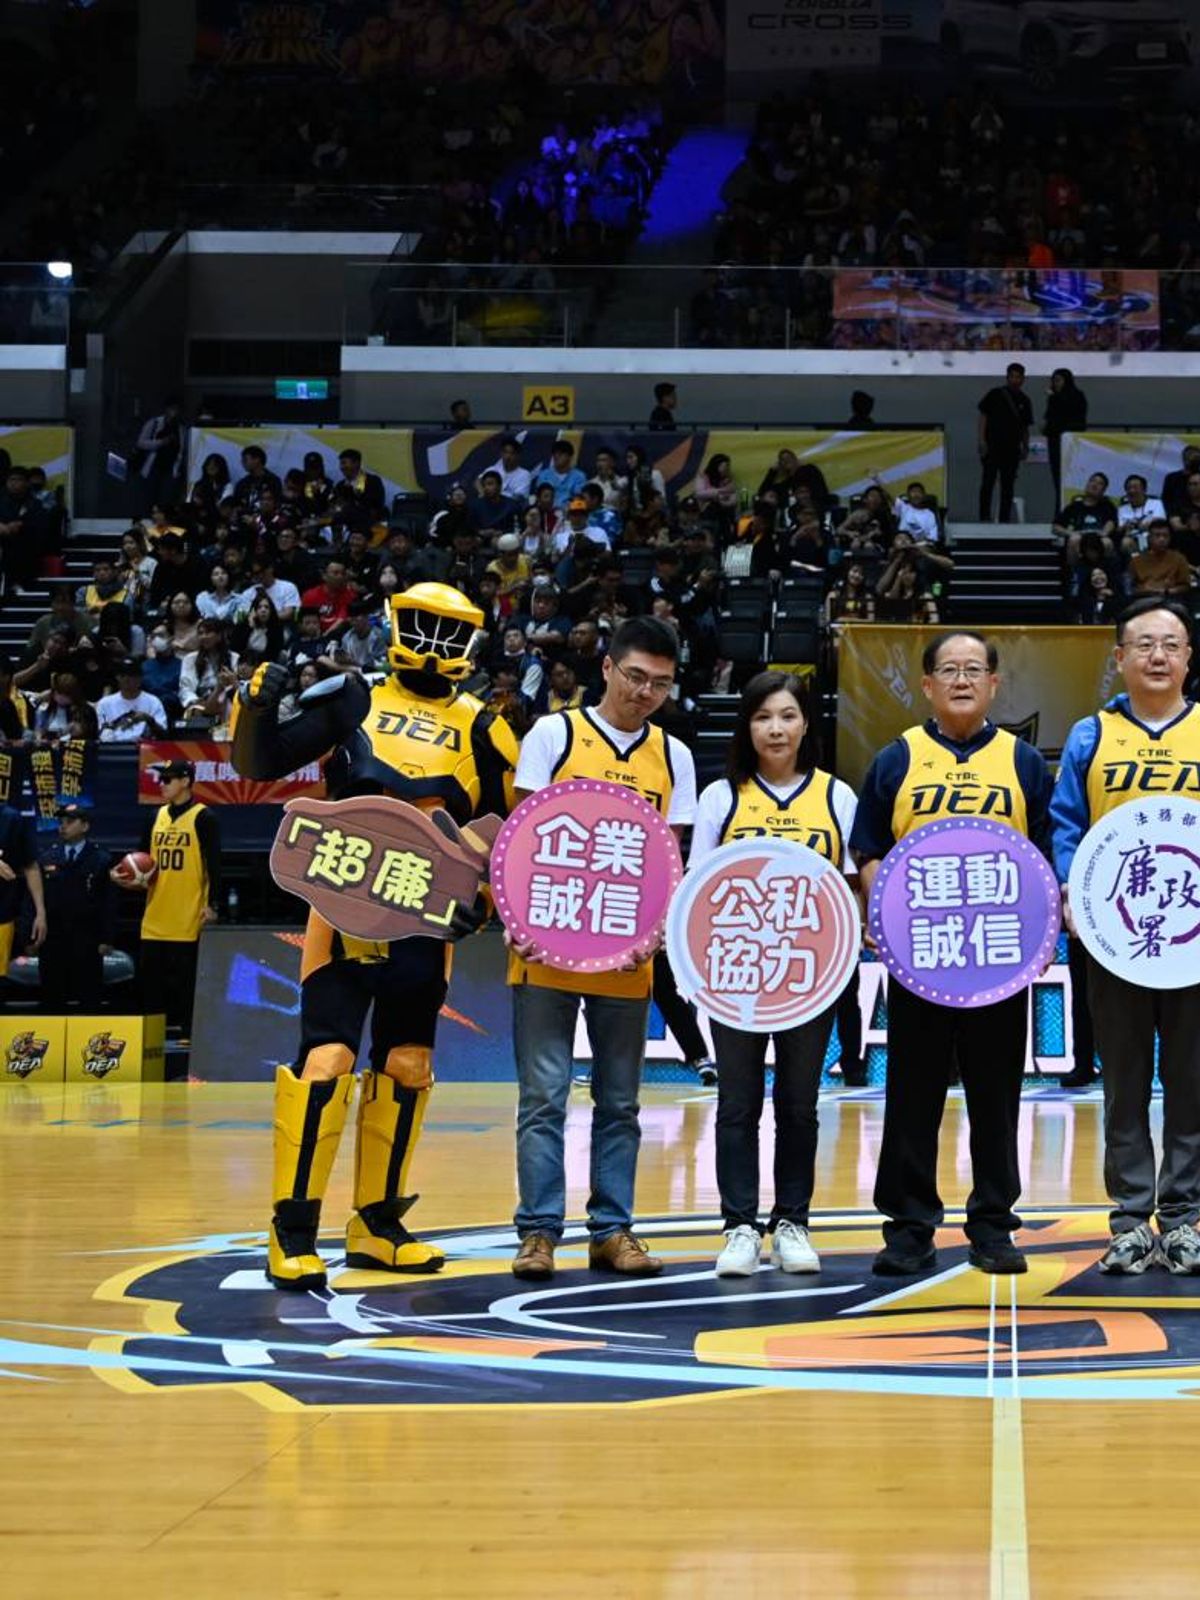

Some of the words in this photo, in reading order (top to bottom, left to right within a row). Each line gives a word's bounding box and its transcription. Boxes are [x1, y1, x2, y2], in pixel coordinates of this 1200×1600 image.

[748, 14, 912, 30] CROSS
[526, 395, 569, 416] A3
[376, 711, 461, 753] DEA
[1137, 748, 1172, 757] CTBC
[604, 770, 638, 784] CTBC
[945, 771, 979, 781] CTBC
[911, 783, 1012, 817] DEA
[766, 816, 799, 827] CTBC
[1134, 808, 1197, 827] 法務部
[534, 814, 647, 877] 企業
[908, 852, 1020, 909] 運動
[528, 874, 641, 936] 誠信
[710, 877, 820, 932] 公私
[911, 914, 1021, 969] 誠信
[706, 937, 816, 993] 協力
